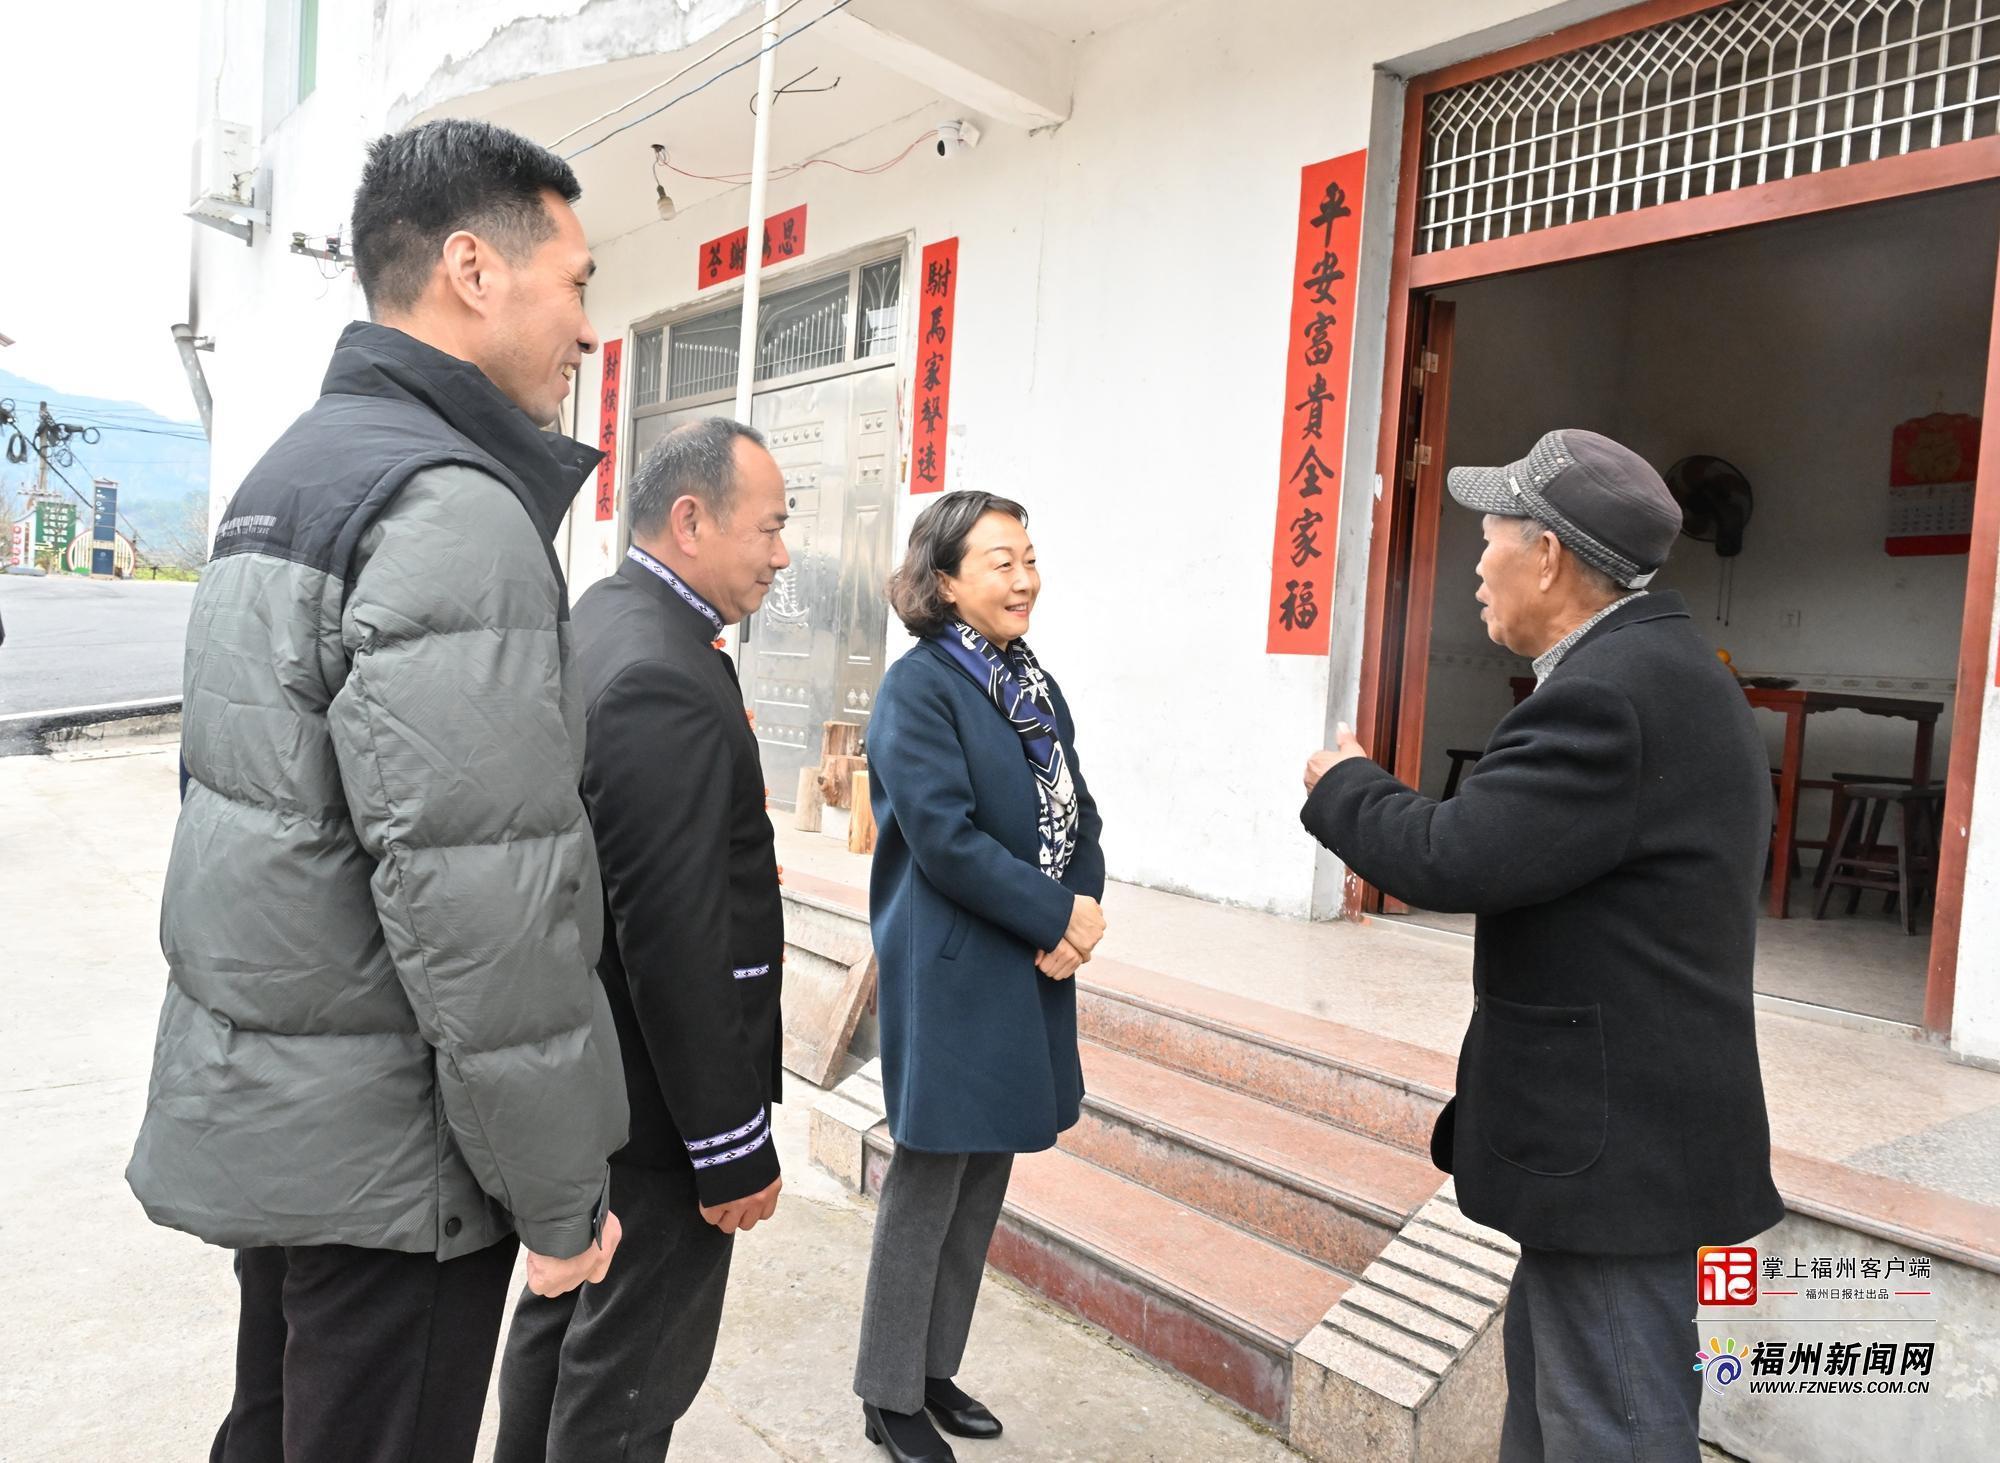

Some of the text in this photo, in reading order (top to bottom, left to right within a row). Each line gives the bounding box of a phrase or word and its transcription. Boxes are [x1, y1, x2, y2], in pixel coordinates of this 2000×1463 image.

[916, 256, 952, 484] 駙馬家聲遠
[1279, 181, 1351, 632] 平安富貴全家福
